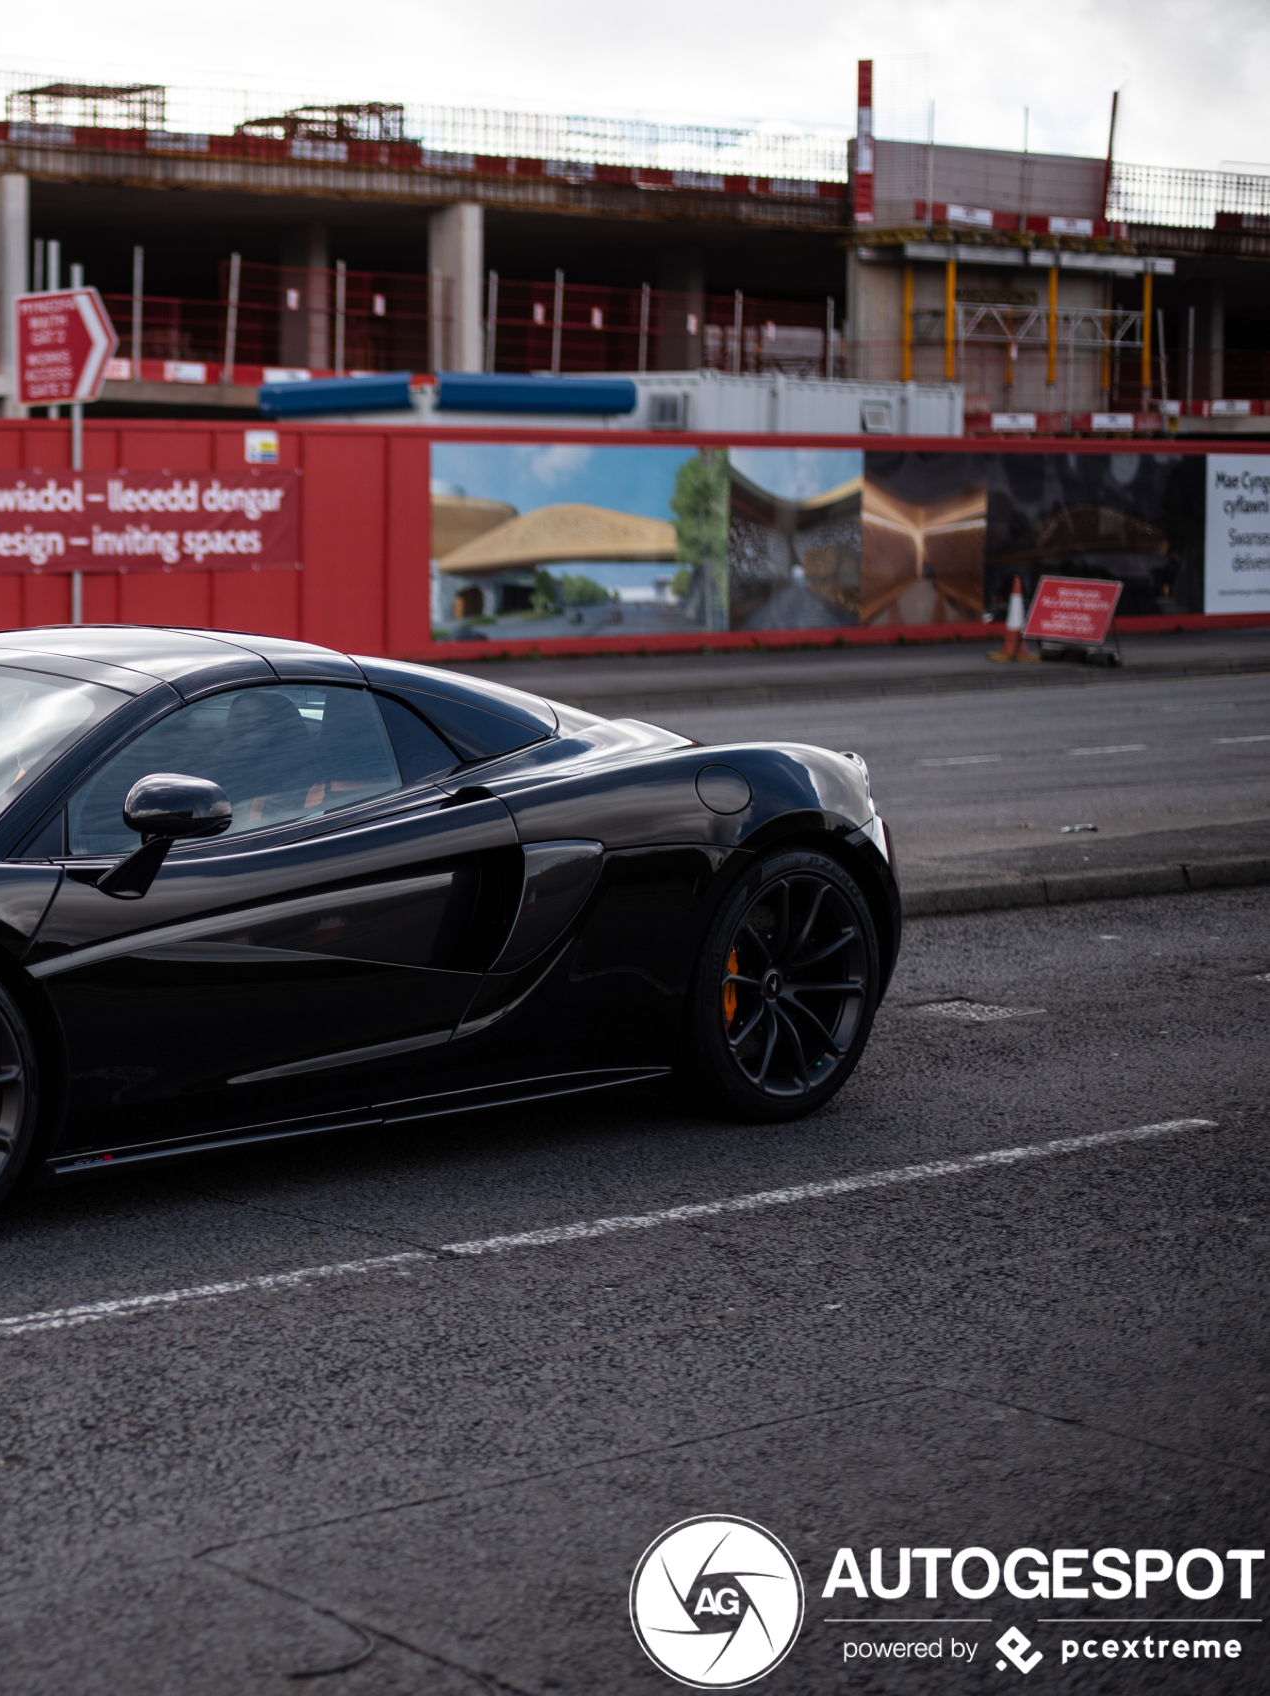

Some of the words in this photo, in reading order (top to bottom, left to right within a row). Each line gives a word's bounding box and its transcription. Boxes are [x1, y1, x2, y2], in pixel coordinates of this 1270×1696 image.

[26, 350, 70, 366] WORKS
[25, 366, 73, 382] ACCESS
[28, 382, 59, 398] GATE
[1215, 471, 1240, 489] Mae
[1241, 470, 1270, 496] Cyng
[108, 480, 199, 513] lleoedd
[202, 481, 284, 521] dengar
[92, 525, 180, 564] inviting
[183, 531, 262, 562] spaces
